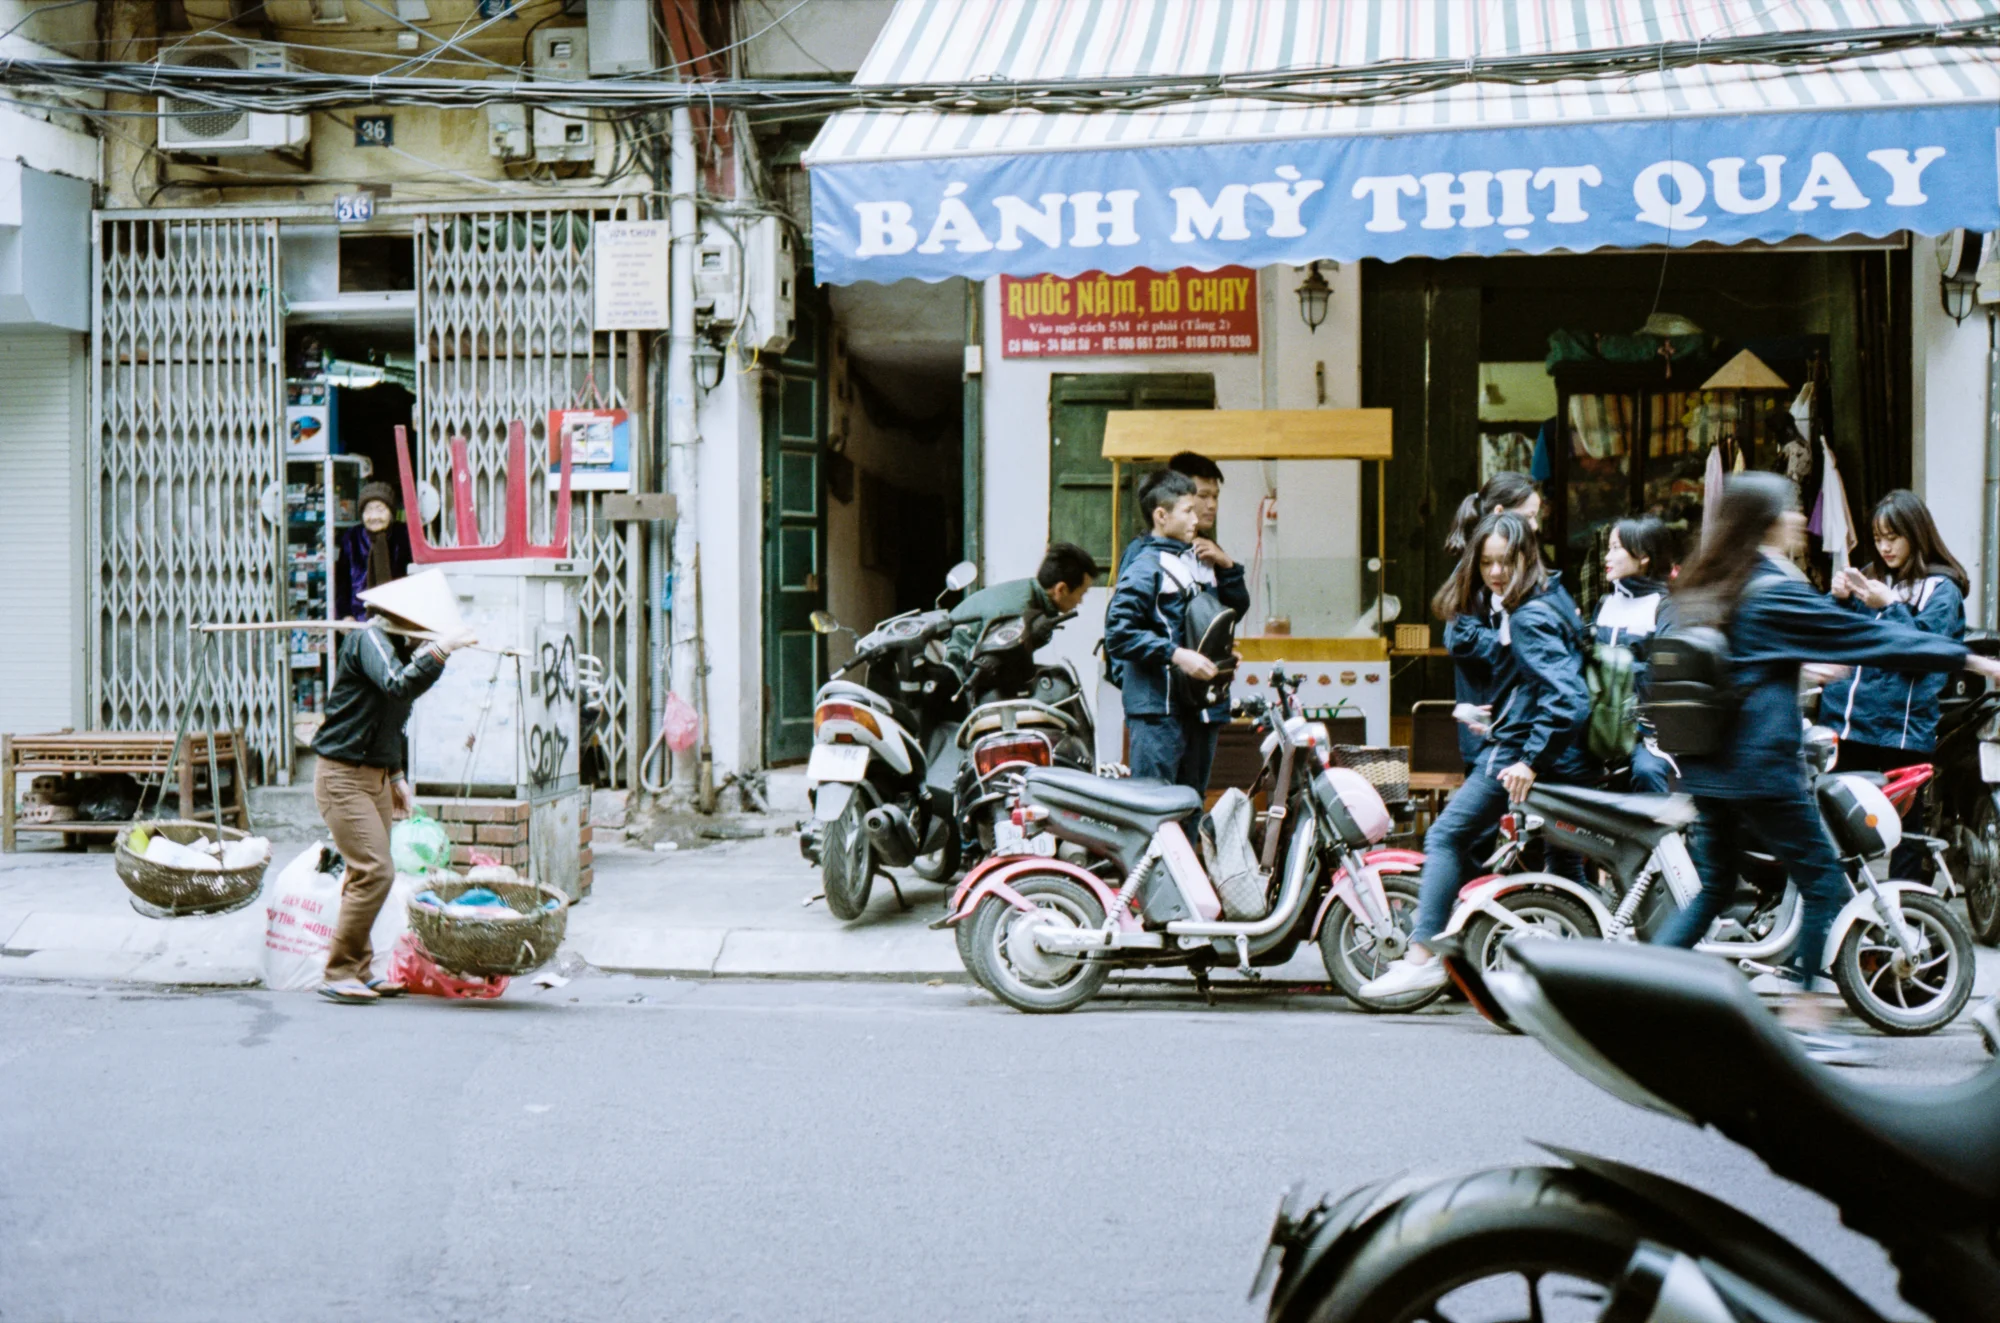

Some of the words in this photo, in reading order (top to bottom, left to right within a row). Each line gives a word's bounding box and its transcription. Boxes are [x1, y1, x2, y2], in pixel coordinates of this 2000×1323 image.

[362, 120, 386, 140] 36
[339, 196, 369, 219] 36
[854, 181, 1141, 257] BÁNH
[1352, 165, 1602, 239] THỊT
[1634, 147, 1946, 231] QUAY
[1187, 277, 1250, 314] CHAY
[1029, 322, 1053, 334] Vào
[1079, 320, 1106, 333] cách
[1109, 320, 1130, 332] 5M
[1219, 318, 1232, 331] 2)
